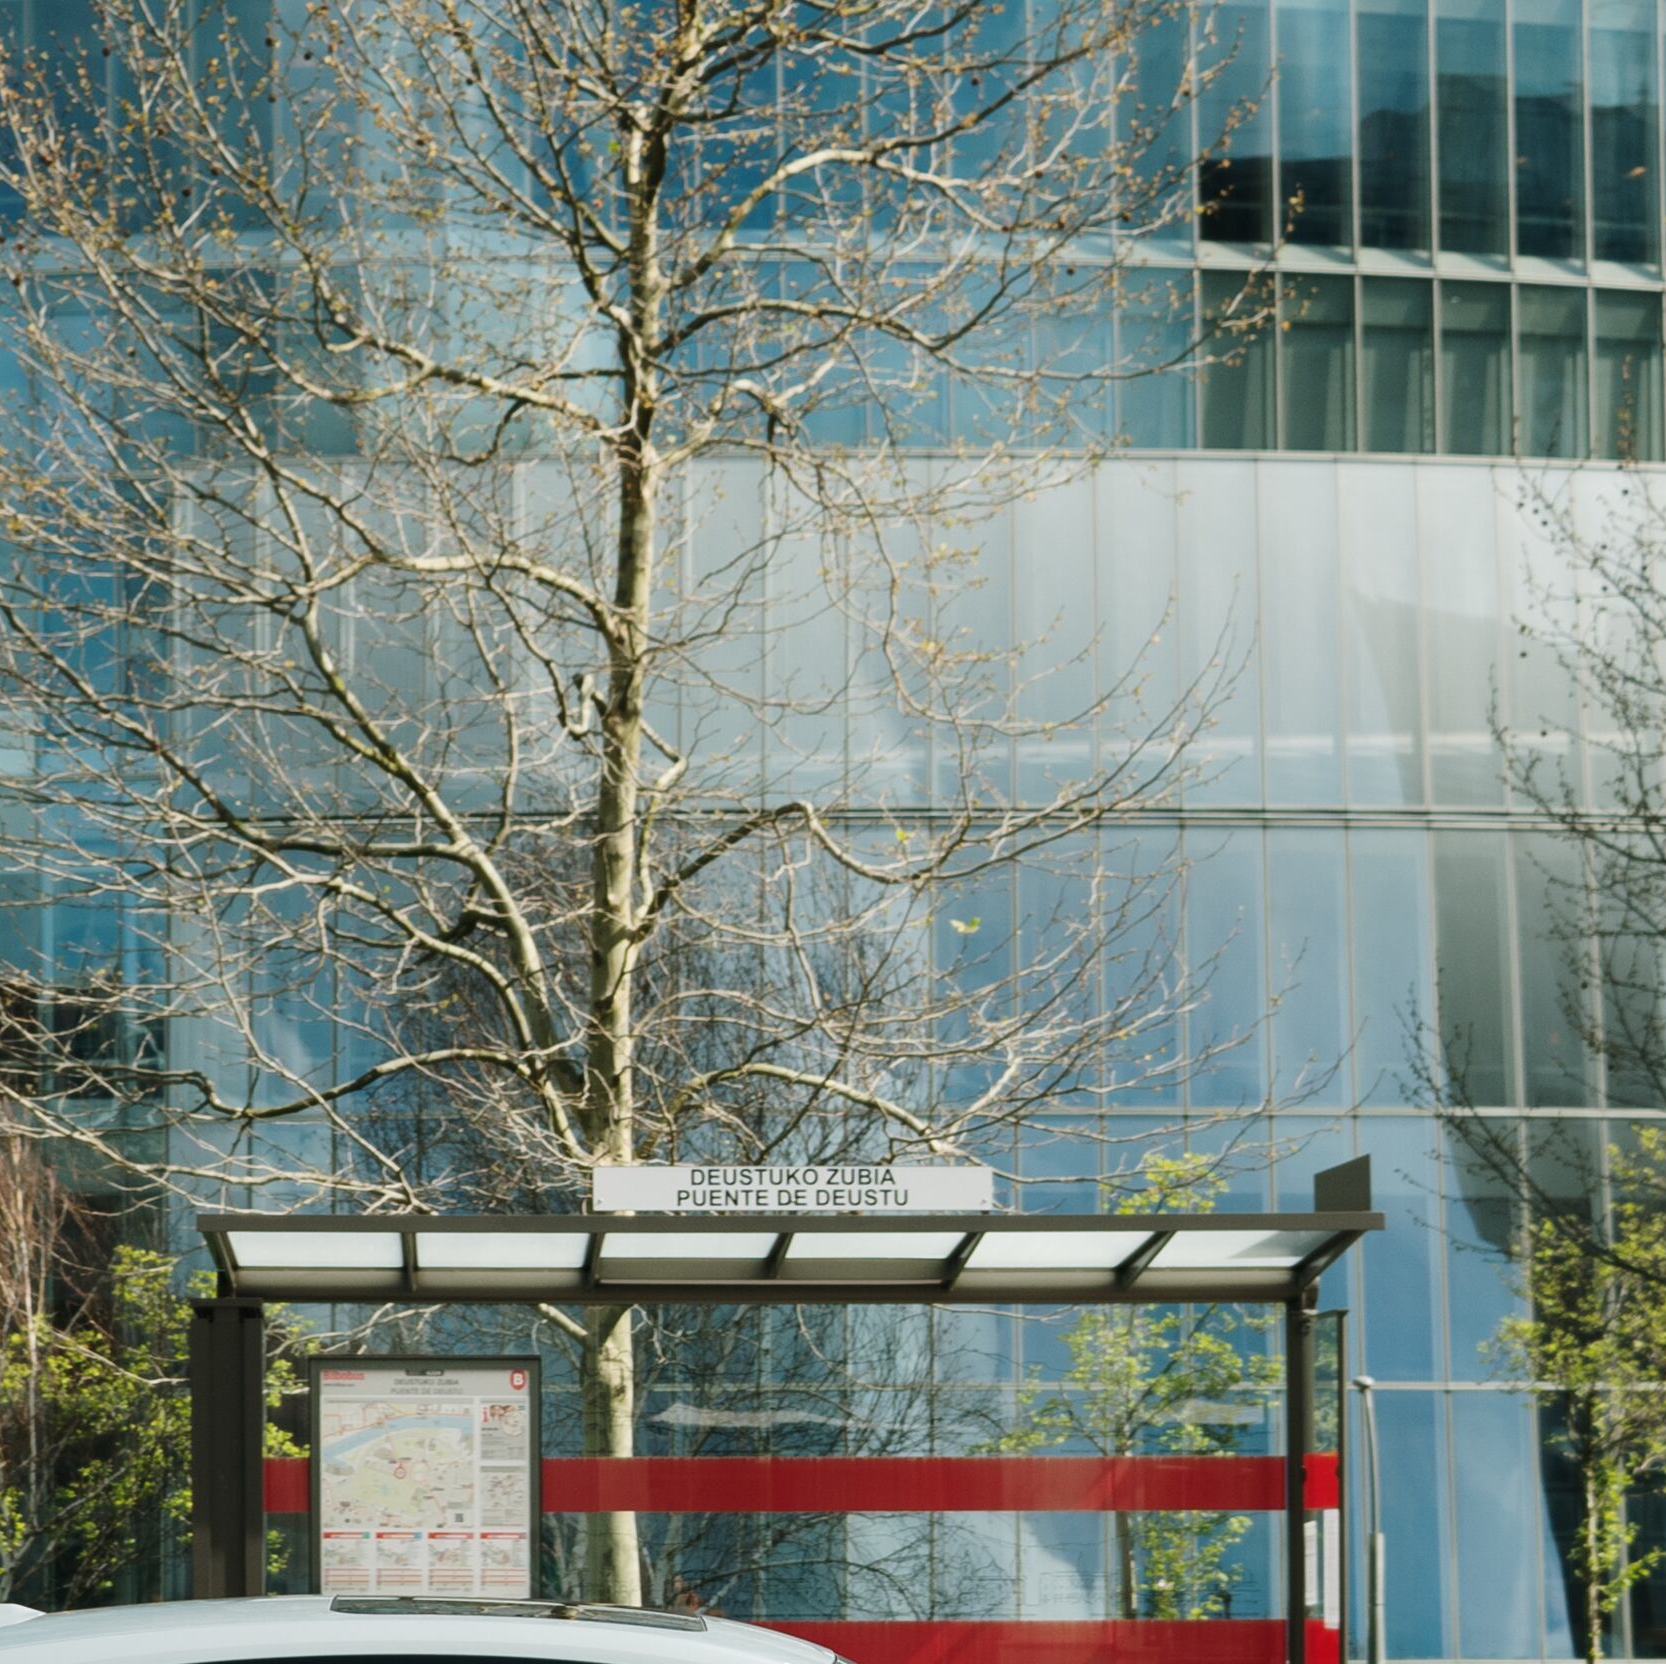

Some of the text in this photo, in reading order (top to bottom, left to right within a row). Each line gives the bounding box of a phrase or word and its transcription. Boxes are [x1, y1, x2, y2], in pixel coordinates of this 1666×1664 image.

[690, 1168, 896, 1186] DEUSTUKO ZUBIA
[676, 1188, 910, 1207] PUENTE DE DEUSTU
